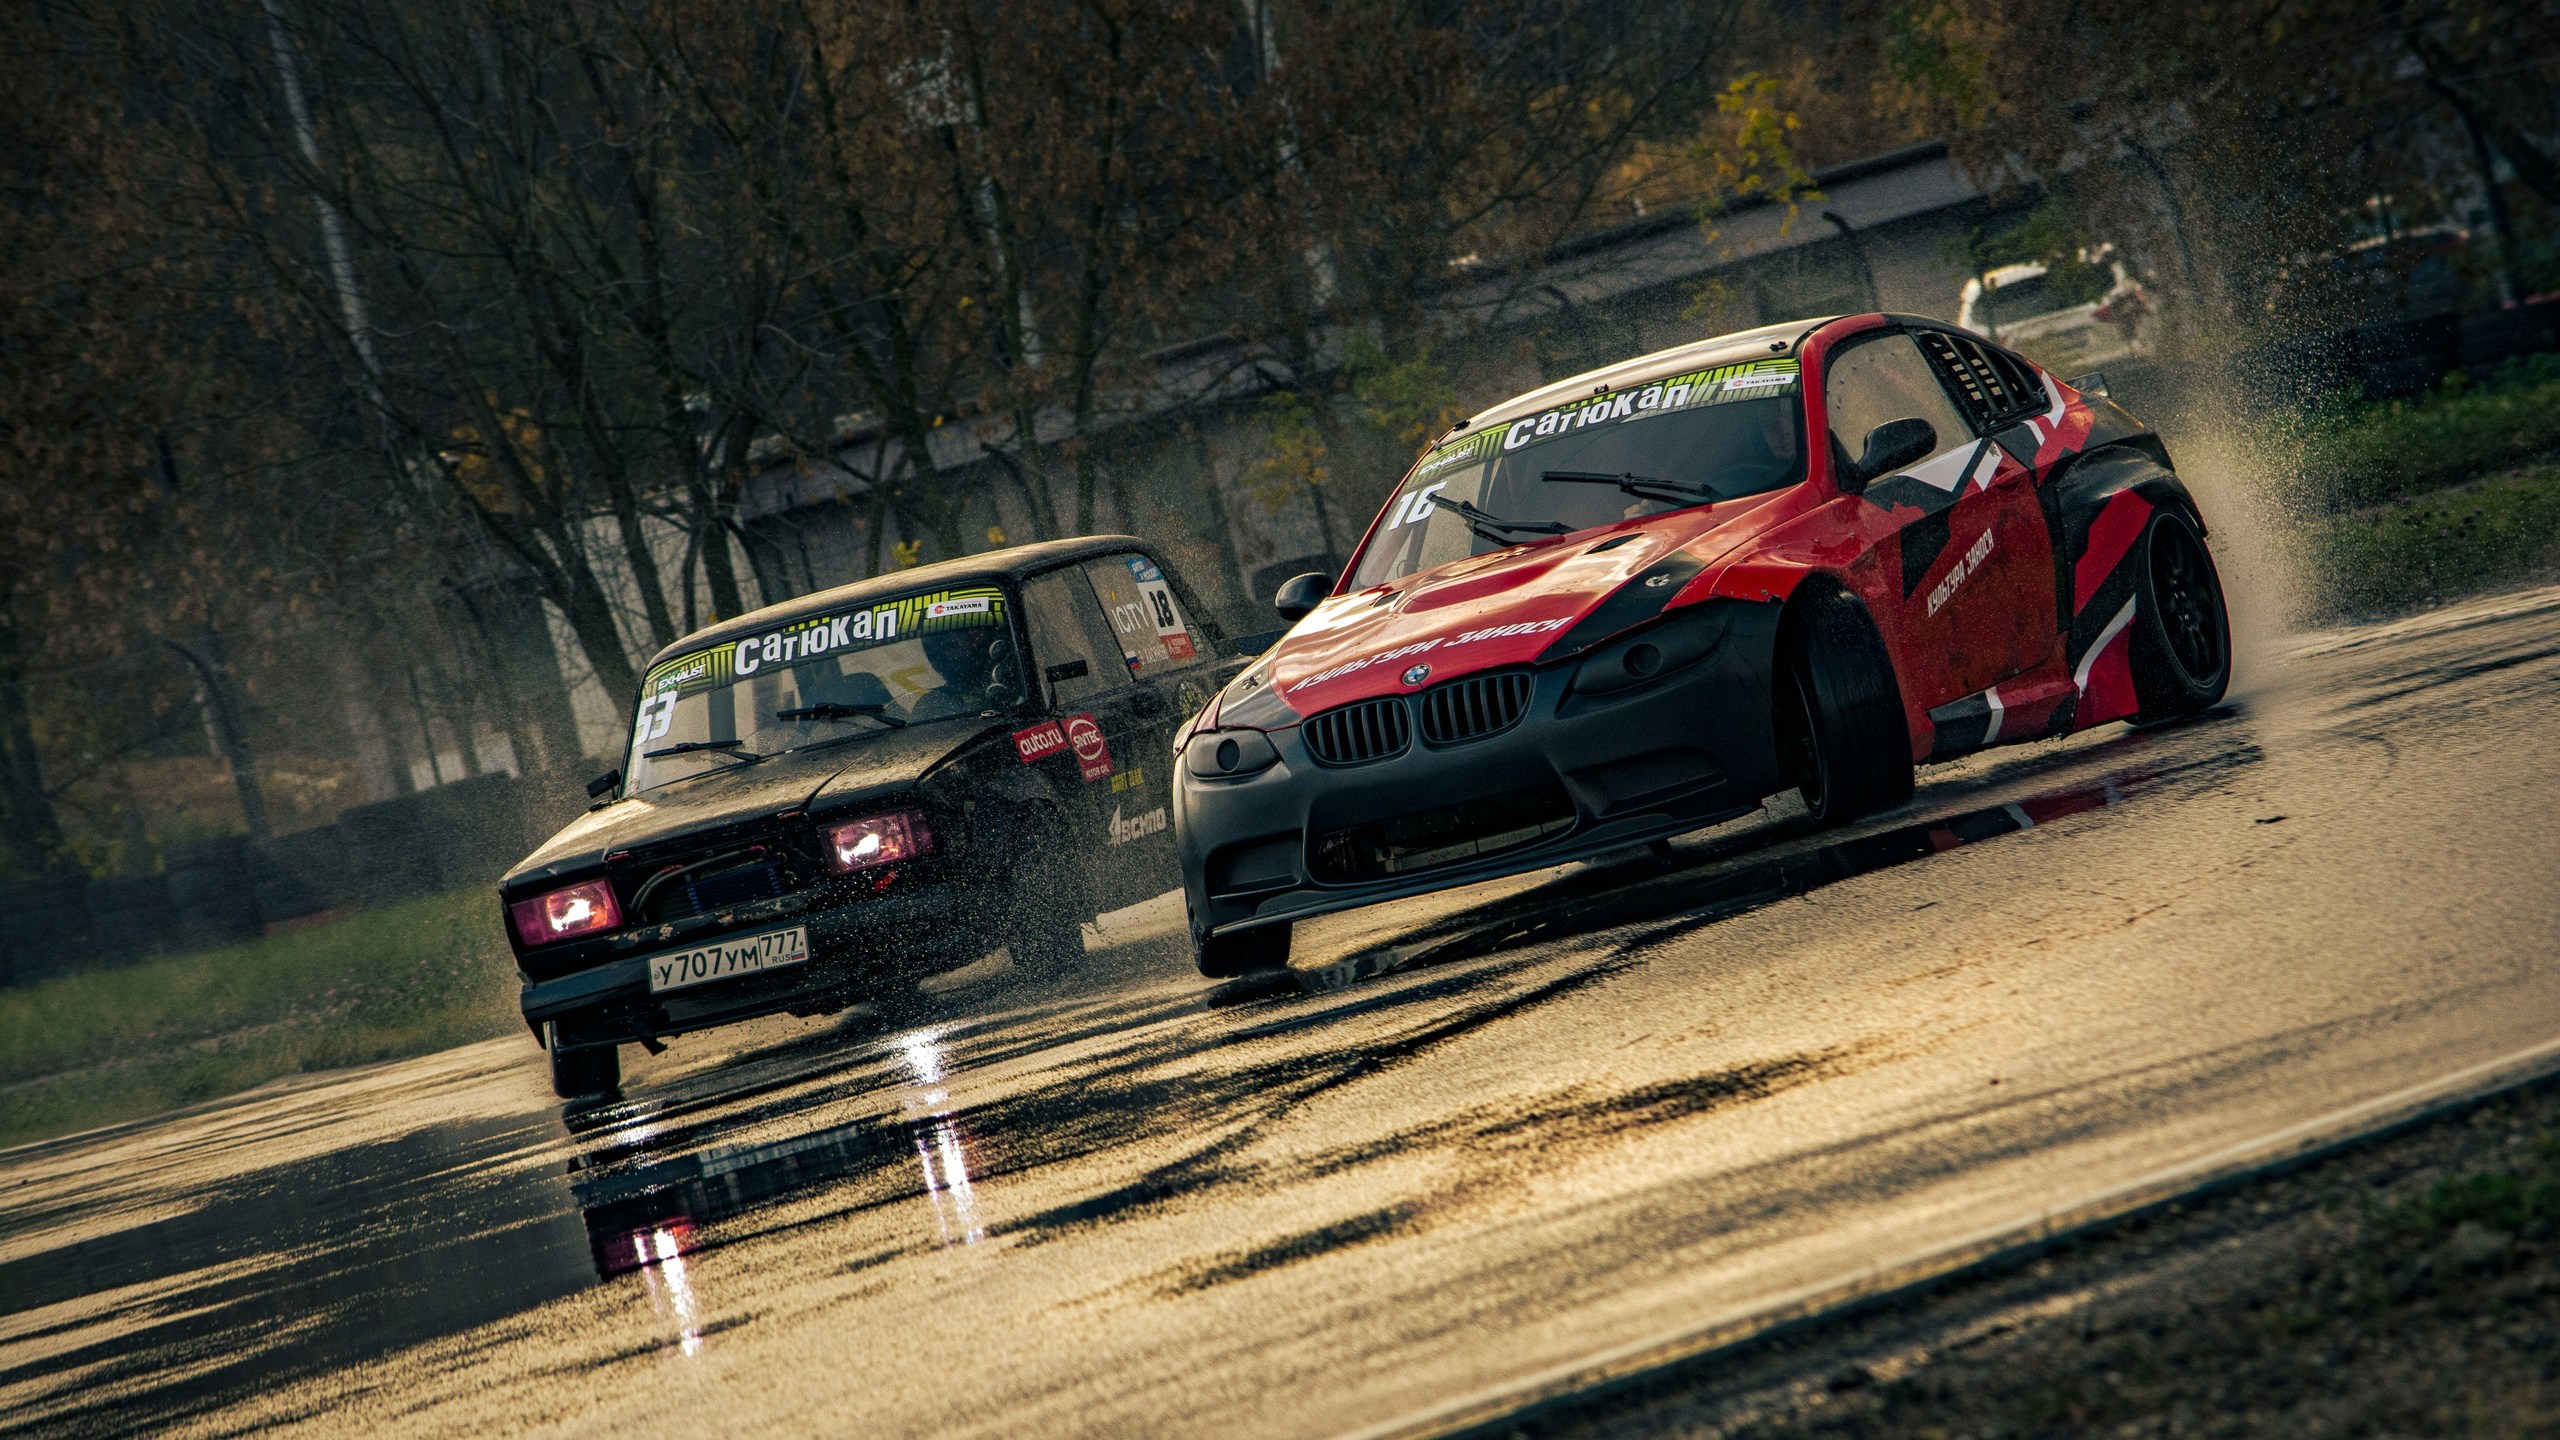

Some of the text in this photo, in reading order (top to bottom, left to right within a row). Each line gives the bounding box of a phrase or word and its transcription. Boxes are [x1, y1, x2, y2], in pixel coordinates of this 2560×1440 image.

[1746, 377, 1786, 385] TAKAYAMA
[1418, 446, 1475, 476] EXHAUST
[1388, 481, 1448, 532] 16
[1927, 527, 1995, 618] КУЛЬТУРА ЗАНОСА
[946, 602, 983, 612] TAKAYAMA
[1149, 590, 1175, 628] 18
[1286, 637, 1445, 693] КУЛЬТУРА
[1443, 615, 1574, 648] ЗАНОСА
[657, 664, 707, 691] EXHAUST
[633, 690, 678, 749] 53
[1019, 728, 1064, 756] auto.ru
[1072, 729, 1101, 749] SINTEC
[760, 930, 799, 957] 777
[772, 953, 791, 964] RUS
